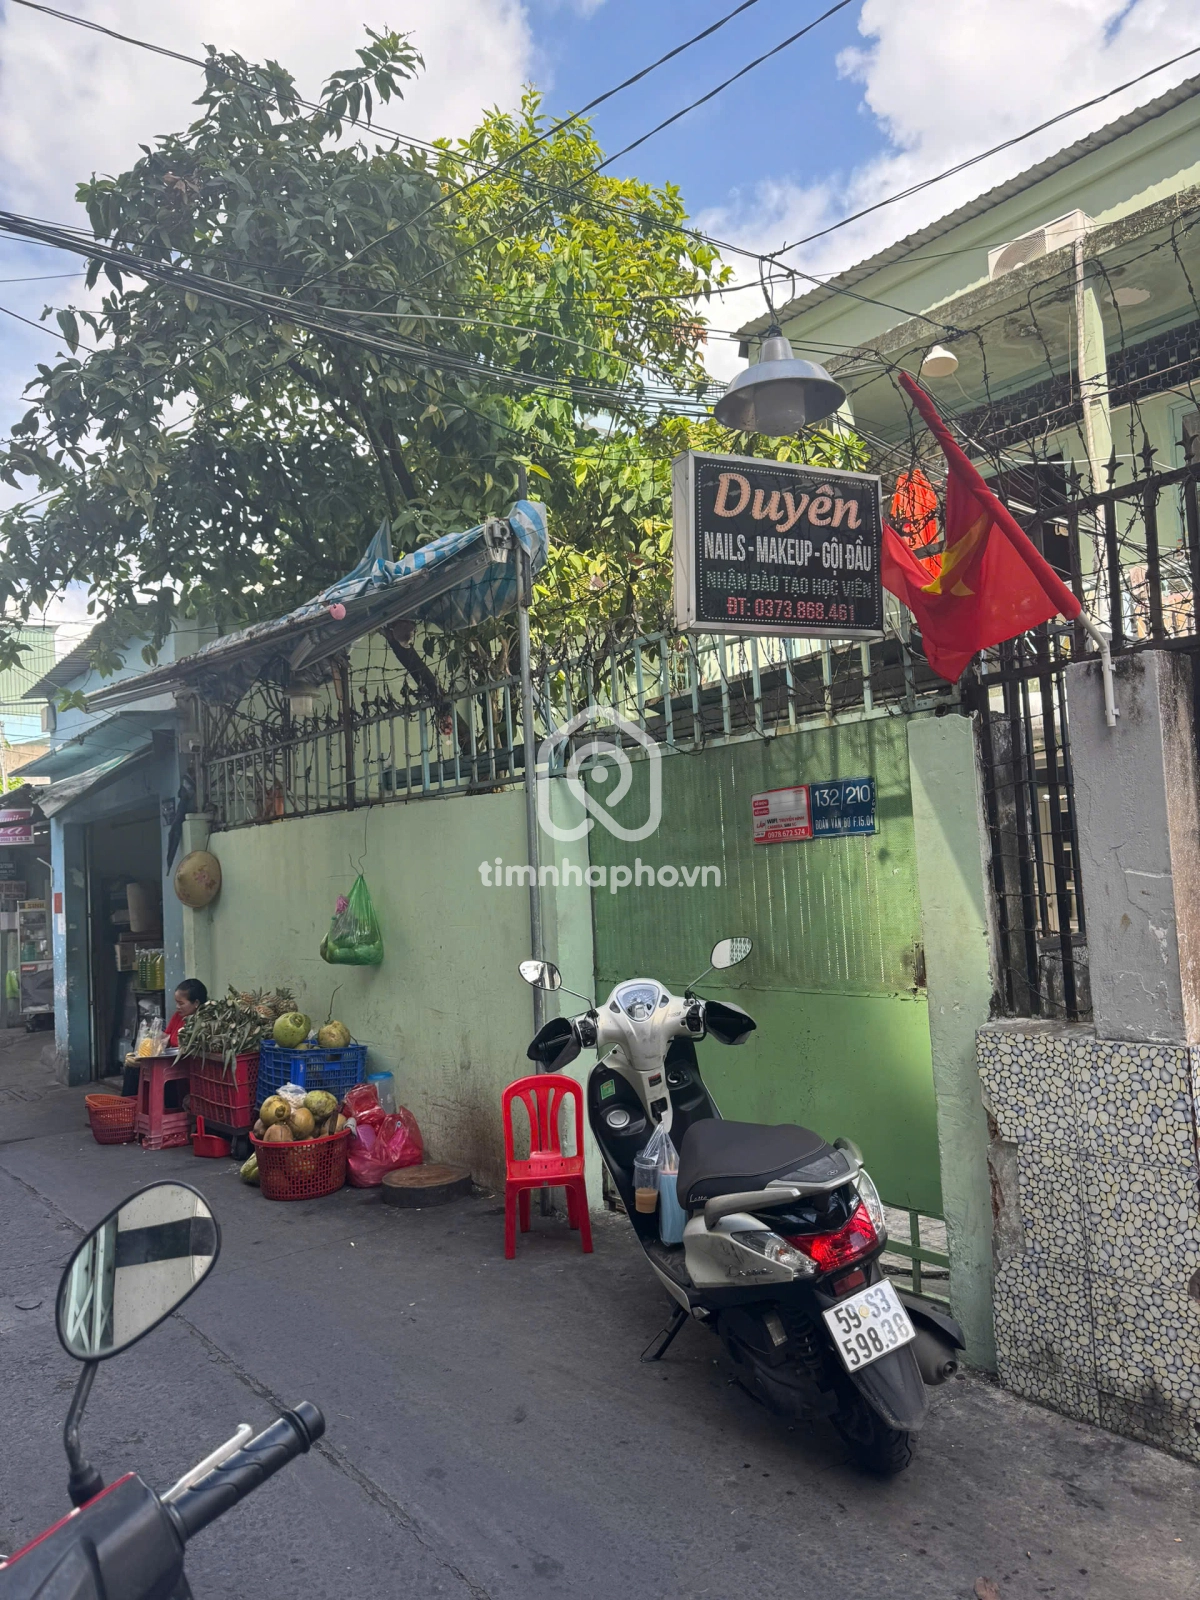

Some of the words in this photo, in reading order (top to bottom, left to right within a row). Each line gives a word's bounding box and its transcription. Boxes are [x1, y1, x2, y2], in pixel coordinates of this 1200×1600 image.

[713, 472, 862, 533] Duyên
[704, 531, 746, 561] NAILS
[756, 535, 813, 567] MAKEUP
[822, 536, 843, 576] GỘI
[845, 535, 872, 572] ĐẦU
[706, 568, 747, 593] NHẬN
[750, 571, 779, 593] ĐÀO
[782, 575, 809, 597] TẠO
[812, 578, 839, 599] HỌC
[842, 577, 872, 598] VIÊN
[727, 596, 751, 616] ĐT:
[754, 598, 855, 622] 0373.868.461
[814, 783, 871, 810] 132/210
